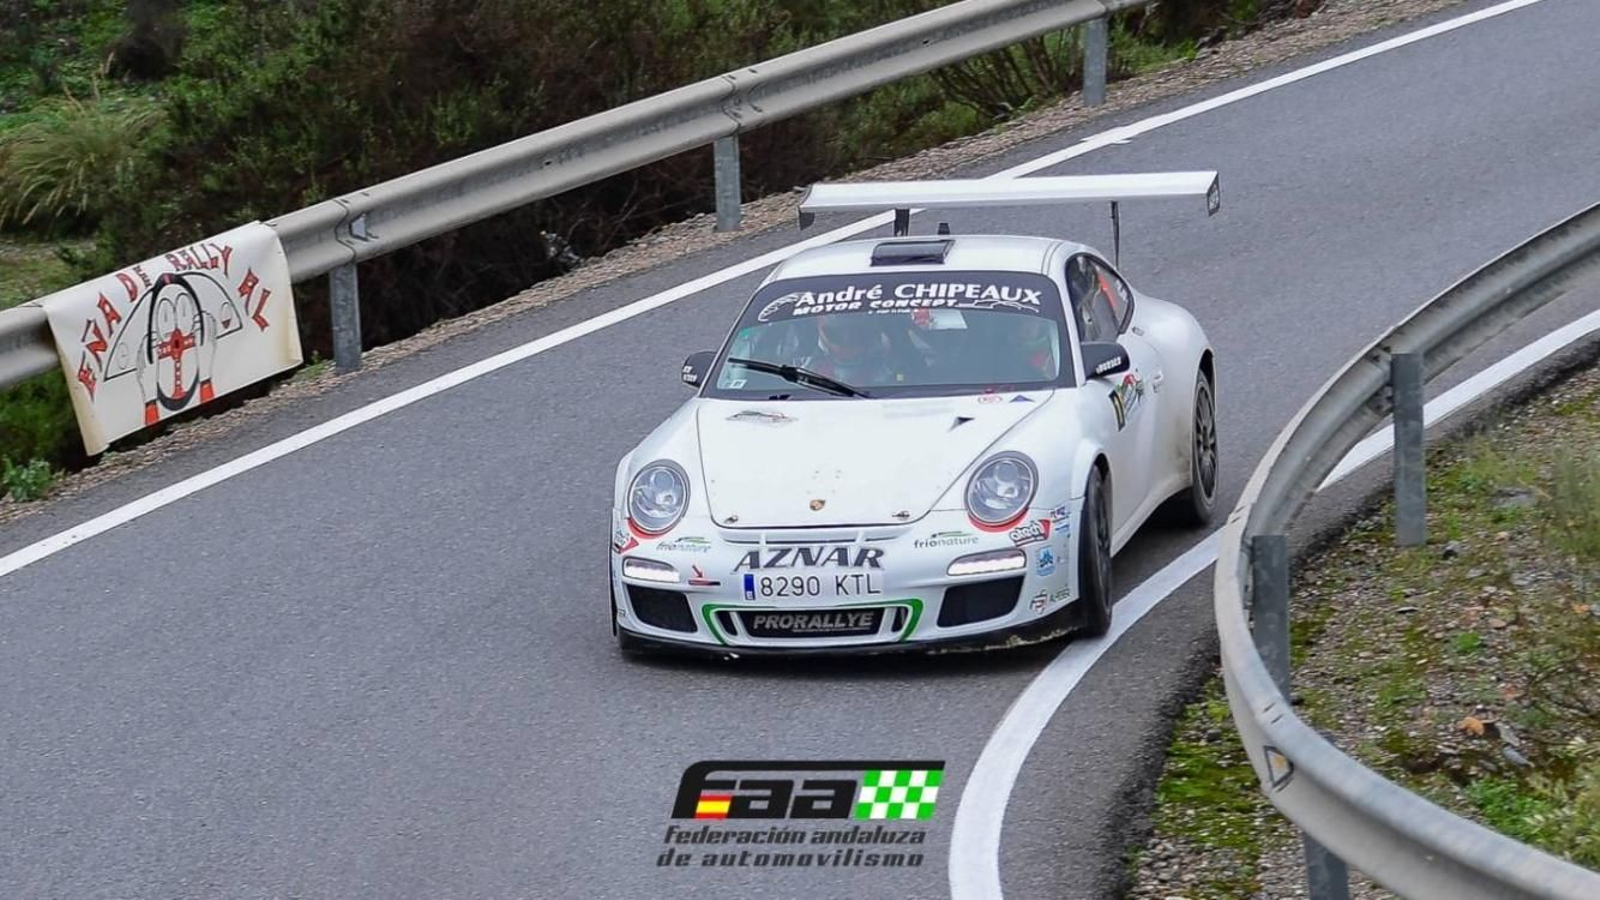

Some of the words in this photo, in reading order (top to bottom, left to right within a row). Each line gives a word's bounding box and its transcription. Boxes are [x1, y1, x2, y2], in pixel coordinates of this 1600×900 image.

[165, 243, 233, 278] RALLY
[793, 301, 862, 315] MOTOR
[869, 299, 958, 309] CONCEPT
[795, 284, 882, 307] André
[895, 284, 1042, 305] CHIPEAUX
[733, 547, 885, 572] AZNAR
[760, 576, 820, 597] 8290
[835, 574, 881, 595] KTL
[753, 612, 874, 630] PRORALLYE
